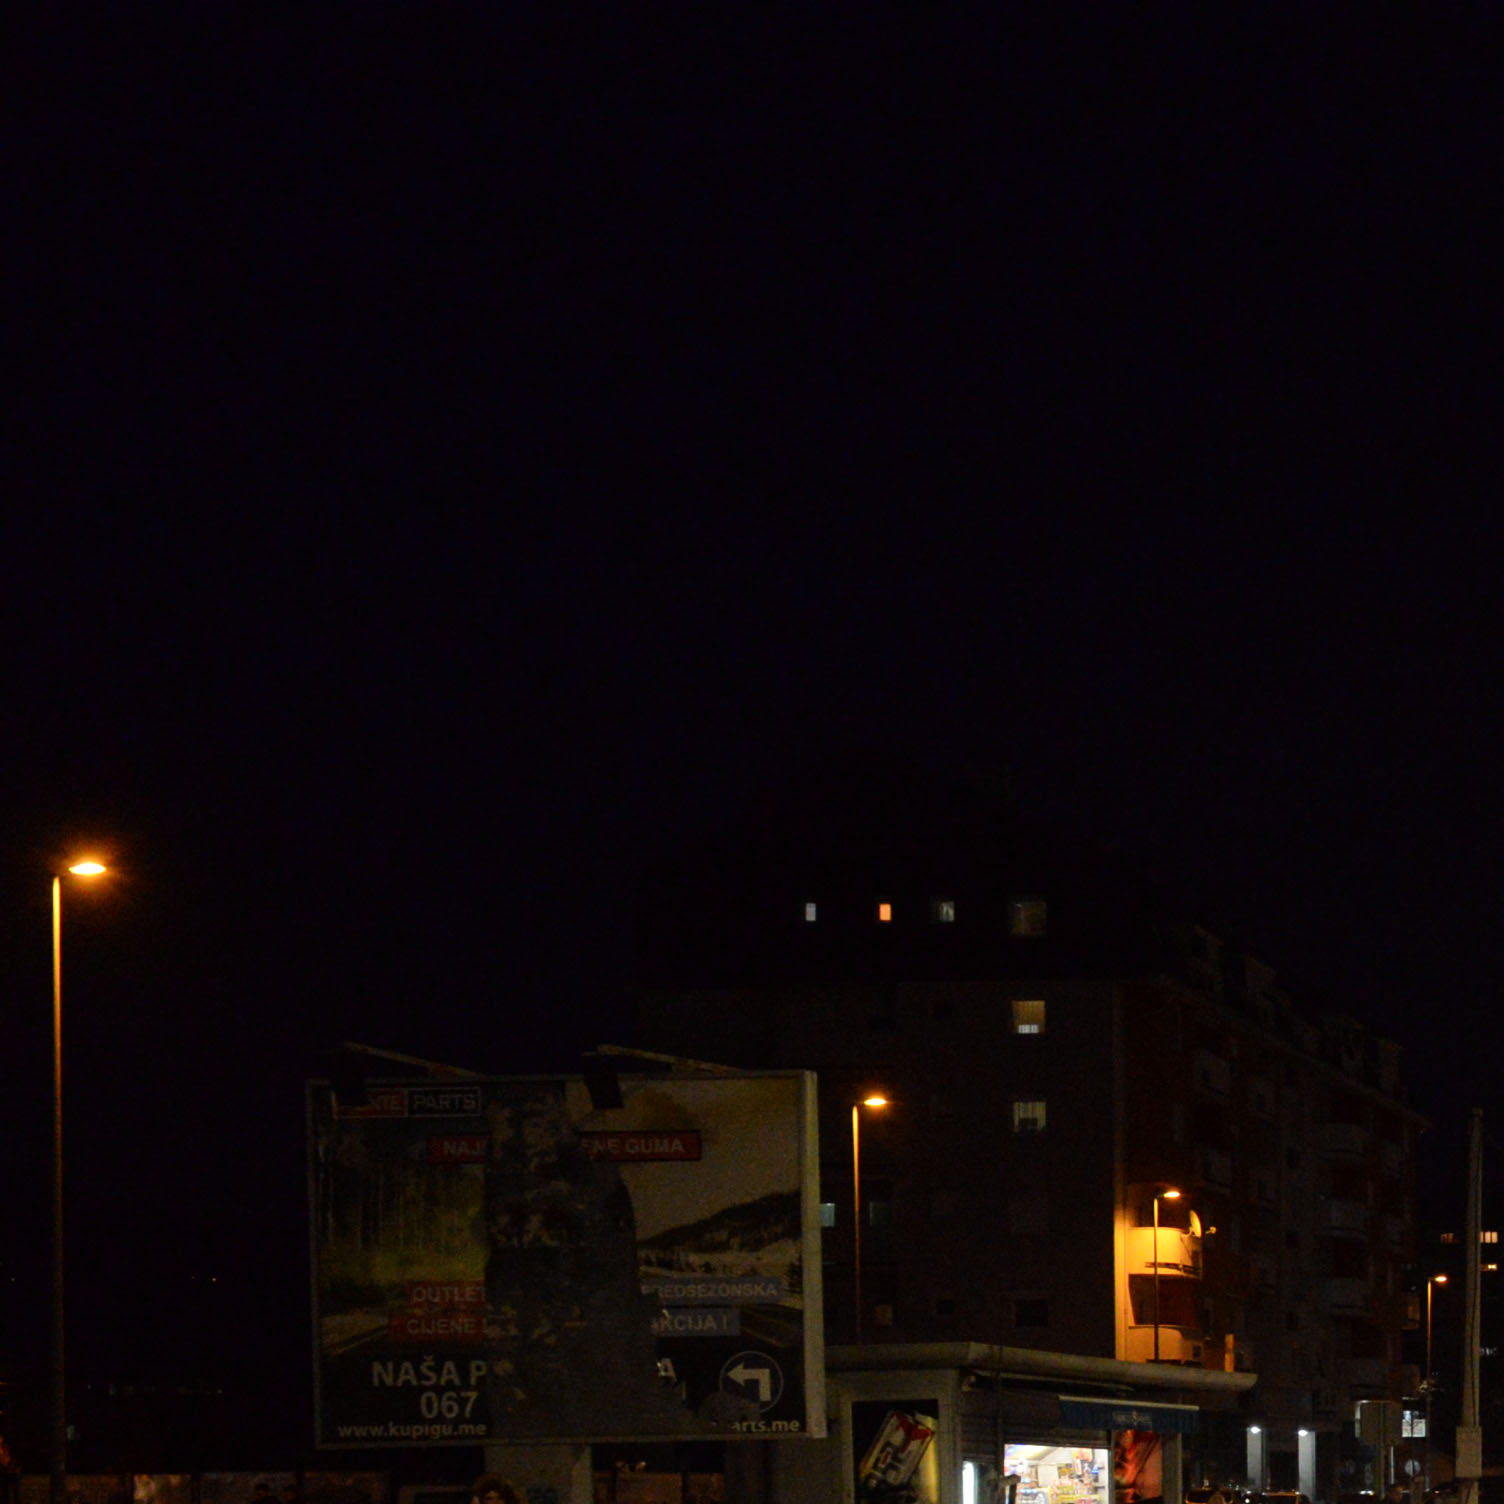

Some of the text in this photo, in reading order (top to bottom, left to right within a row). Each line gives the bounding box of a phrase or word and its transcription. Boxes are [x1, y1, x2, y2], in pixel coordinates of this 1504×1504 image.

[413, 1094, 476, 1111] PARTS
[443, 1139, 487, 1157] NAJ
[624, 1138, 685, 1153] GUMA
[371, 1353, 461, 1387] NAŠA
[420, 1391, 480, 1419] 067
[338, 1421, 488, 1439] www.kupigu.me
